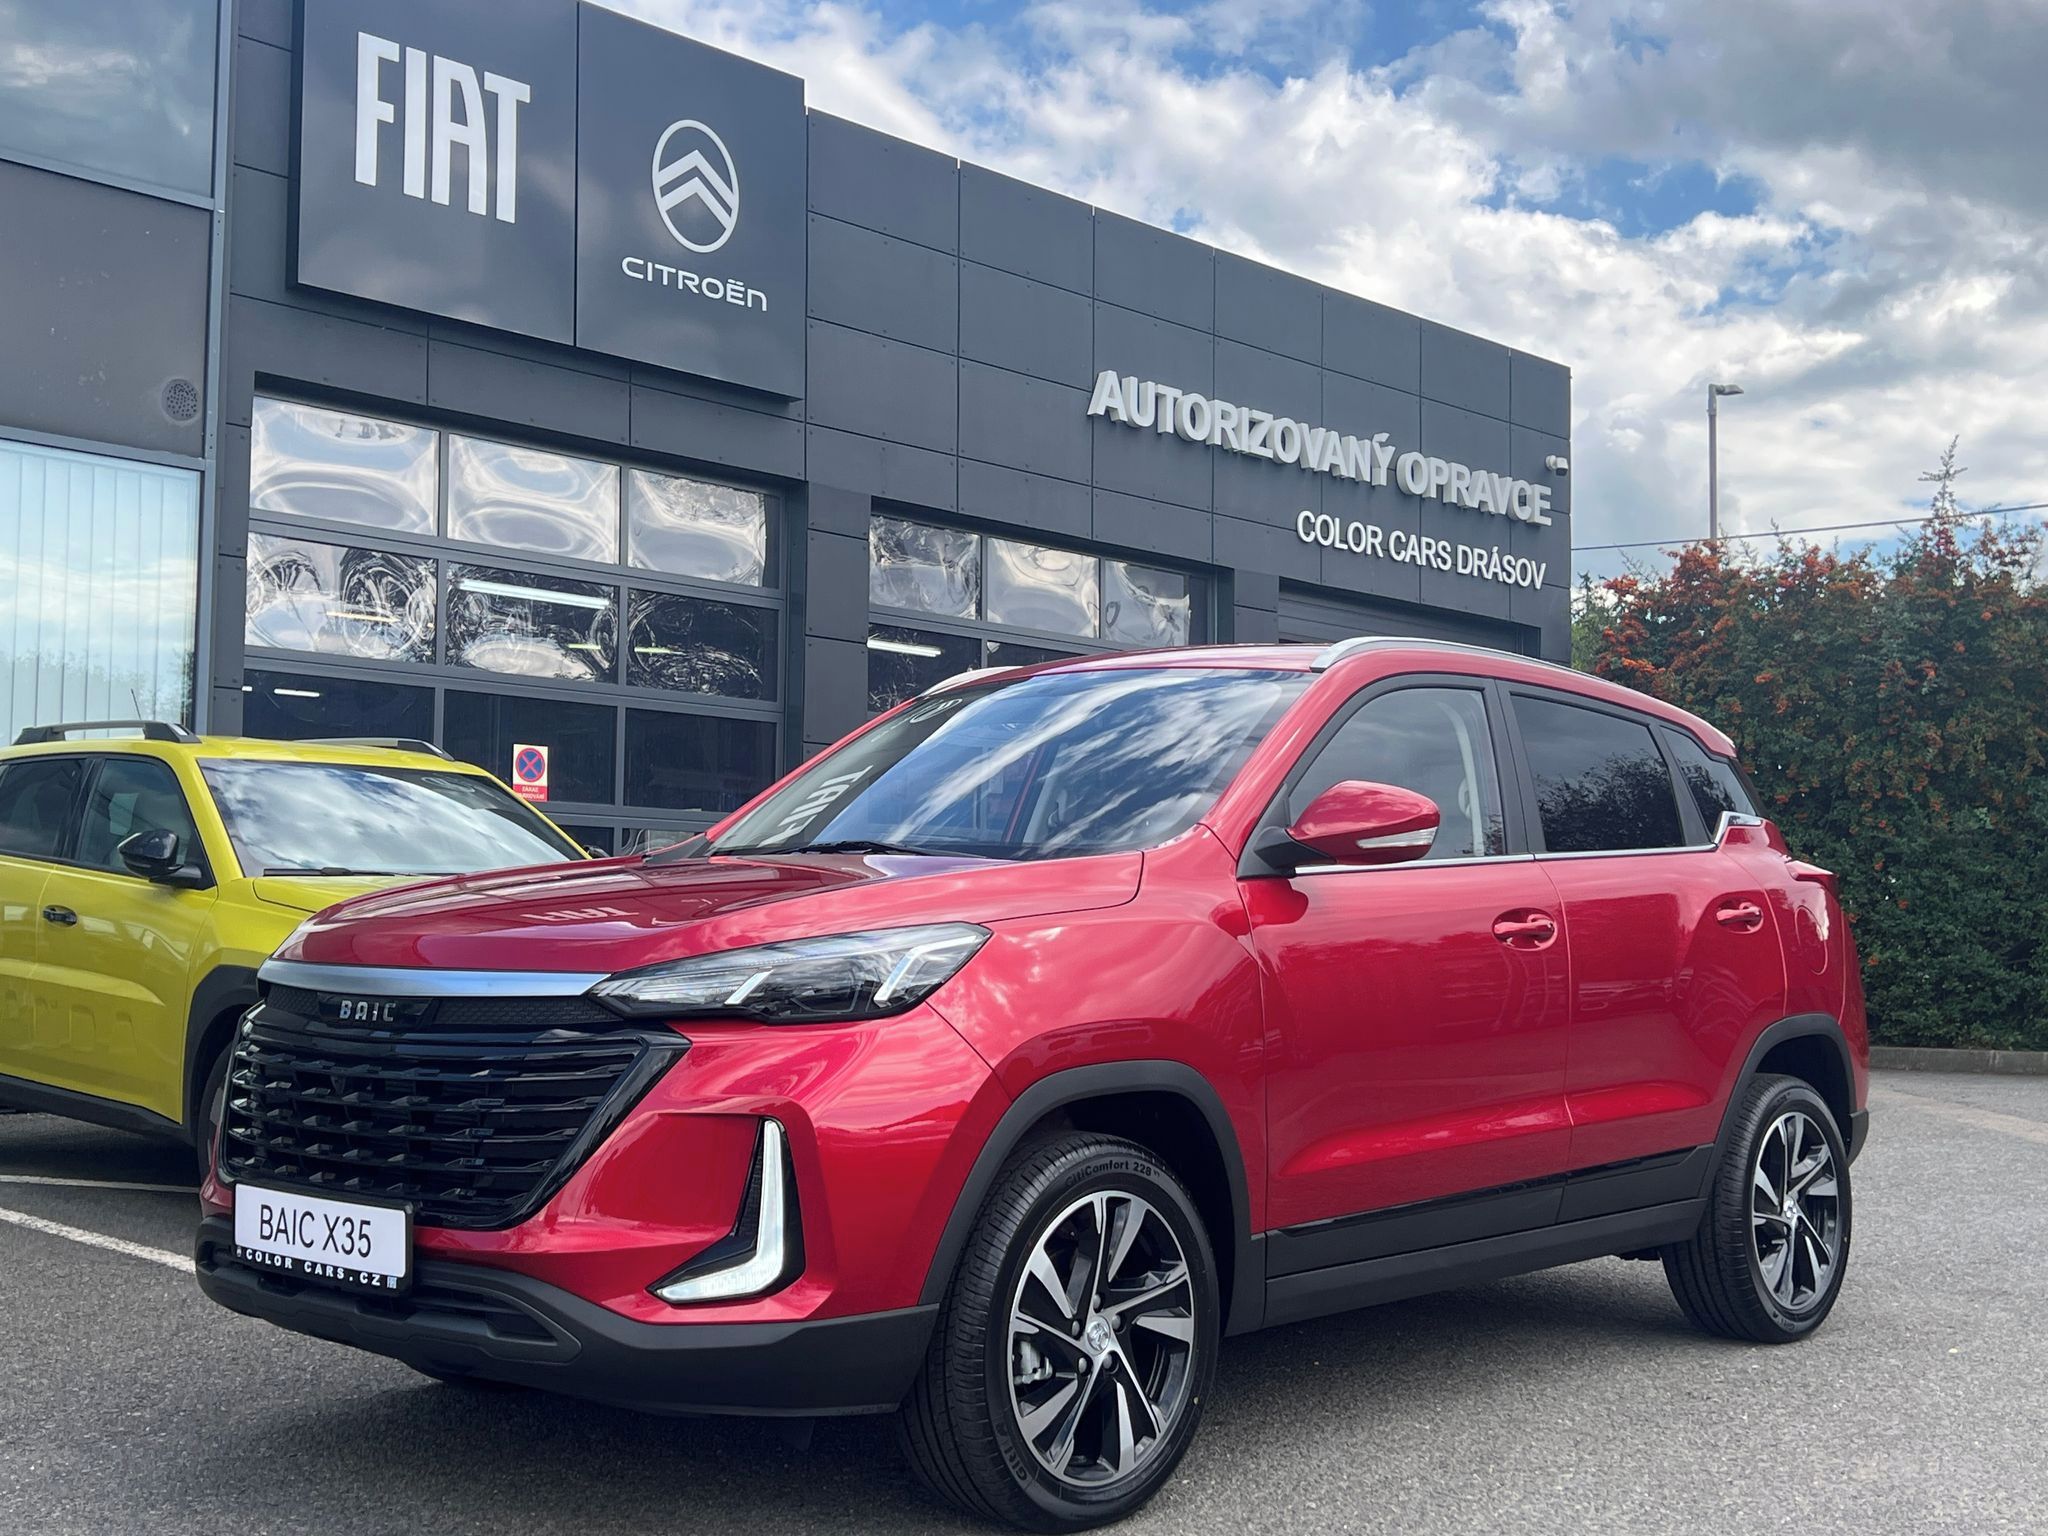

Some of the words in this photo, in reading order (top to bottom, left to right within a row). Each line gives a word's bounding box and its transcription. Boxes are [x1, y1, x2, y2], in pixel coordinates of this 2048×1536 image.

[355, 31, 531, 224] FIAT
[1086, 369, 1396, 487] AUTORIZOVANÝ
[1396, 451, 1552, 527] OPRAVCE
[1296, 510, 1384, 558] COLOR
[1388, 530, 1452, 572] CARS
[1456, 546, 1546, 590] DRÁSOV
[339, 999, 396, 1022] BAIC
[1133, 1161, 1152, 1177] 228
[259, 1204, 315, 1248] BAIC
[322, 1213, 372, 1258] X35
[245, 1248, 294, 1269] COLOR
